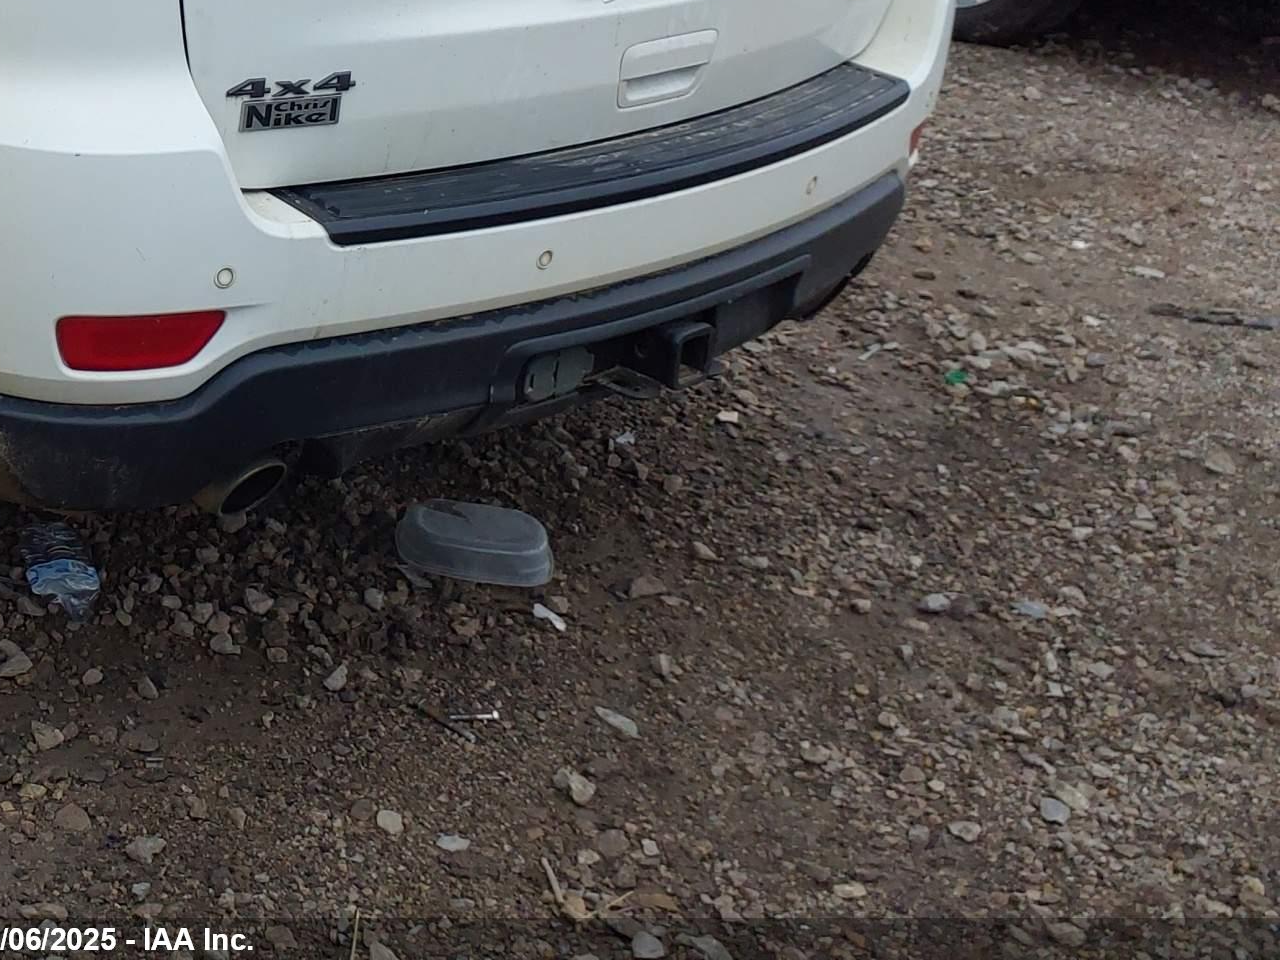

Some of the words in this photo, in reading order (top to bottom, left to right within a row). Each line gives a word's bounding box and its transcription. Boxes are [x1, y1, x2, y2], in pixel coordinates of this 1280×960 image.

[226, 71, 356, 98] 4x4
[245, 98, 339, 129] Nikel
[273, 99, 331, 113] Chris
